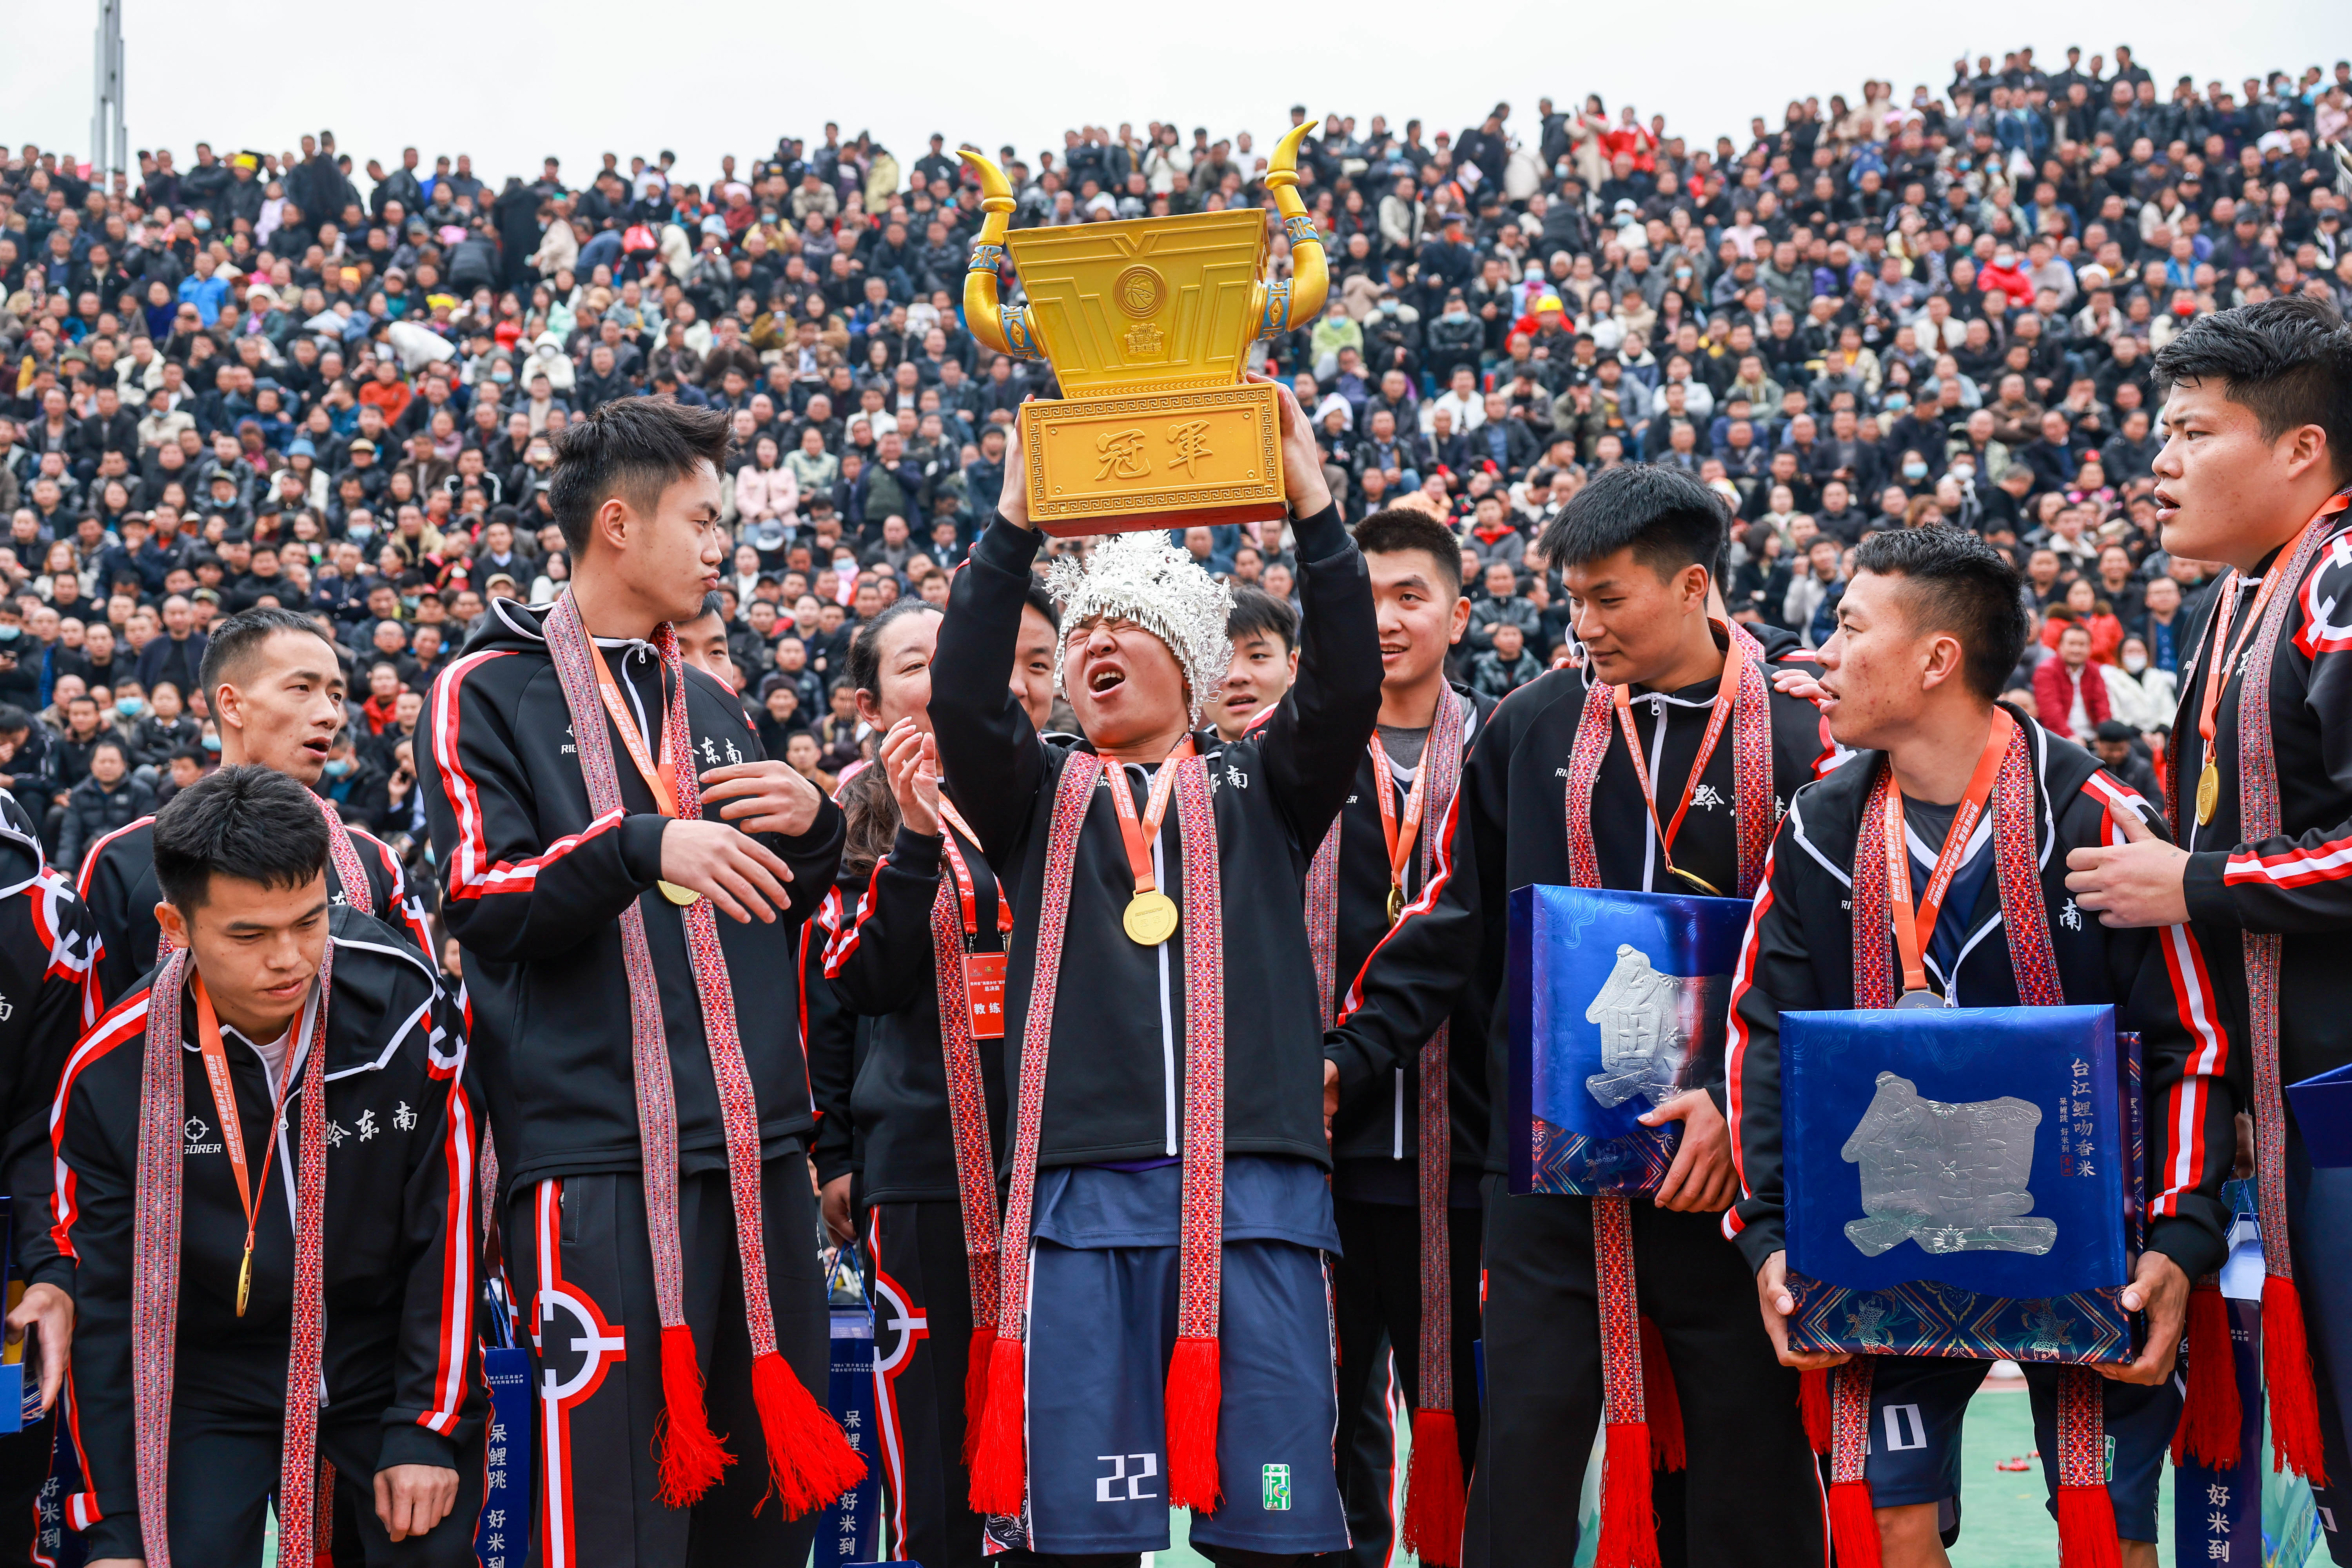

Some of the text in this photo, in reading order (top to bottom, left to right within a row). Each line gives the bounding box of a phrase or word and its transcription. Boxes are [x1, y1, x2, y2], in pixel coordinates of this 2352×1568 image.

[1094, 420, 1213, 480] 冠軍
[2268, 572, 2279, 592] LEAGUE
[1715, 696, 1723, 718] GUIZHOU
[608, 684, 655, 775] GUIZHOU COUNTRY BASKETBALL LEAGUE
[1630, 726, 1639, 753] BASKETBALL
[1707, 719, 1715, 741] COUNTRY
[1695, 742, 1708, 769] BASKETBALL
[1927, 799, 1971, 901] GUIZHOU COUNTRY BASKETBALL LEAGUE
[974, 1003, 1001, 1014] 教练
[216, 1056, 225, 1075] LEAGUE
[222, 1078, 233, 1110] BASKETBALL
[230, 1113, 238, 1137] COUNTRY
[2059, 1097, 2069, 1152] 呆鲤跳 好米到
[2071, 1058, 2096, 1177] 台江鲤吻香米
[1096, 1453, 1157, 1501] 22
[839, 1491, 858, 1556] 好米到
[2207, 1483, 2230, 1563] 好米到
